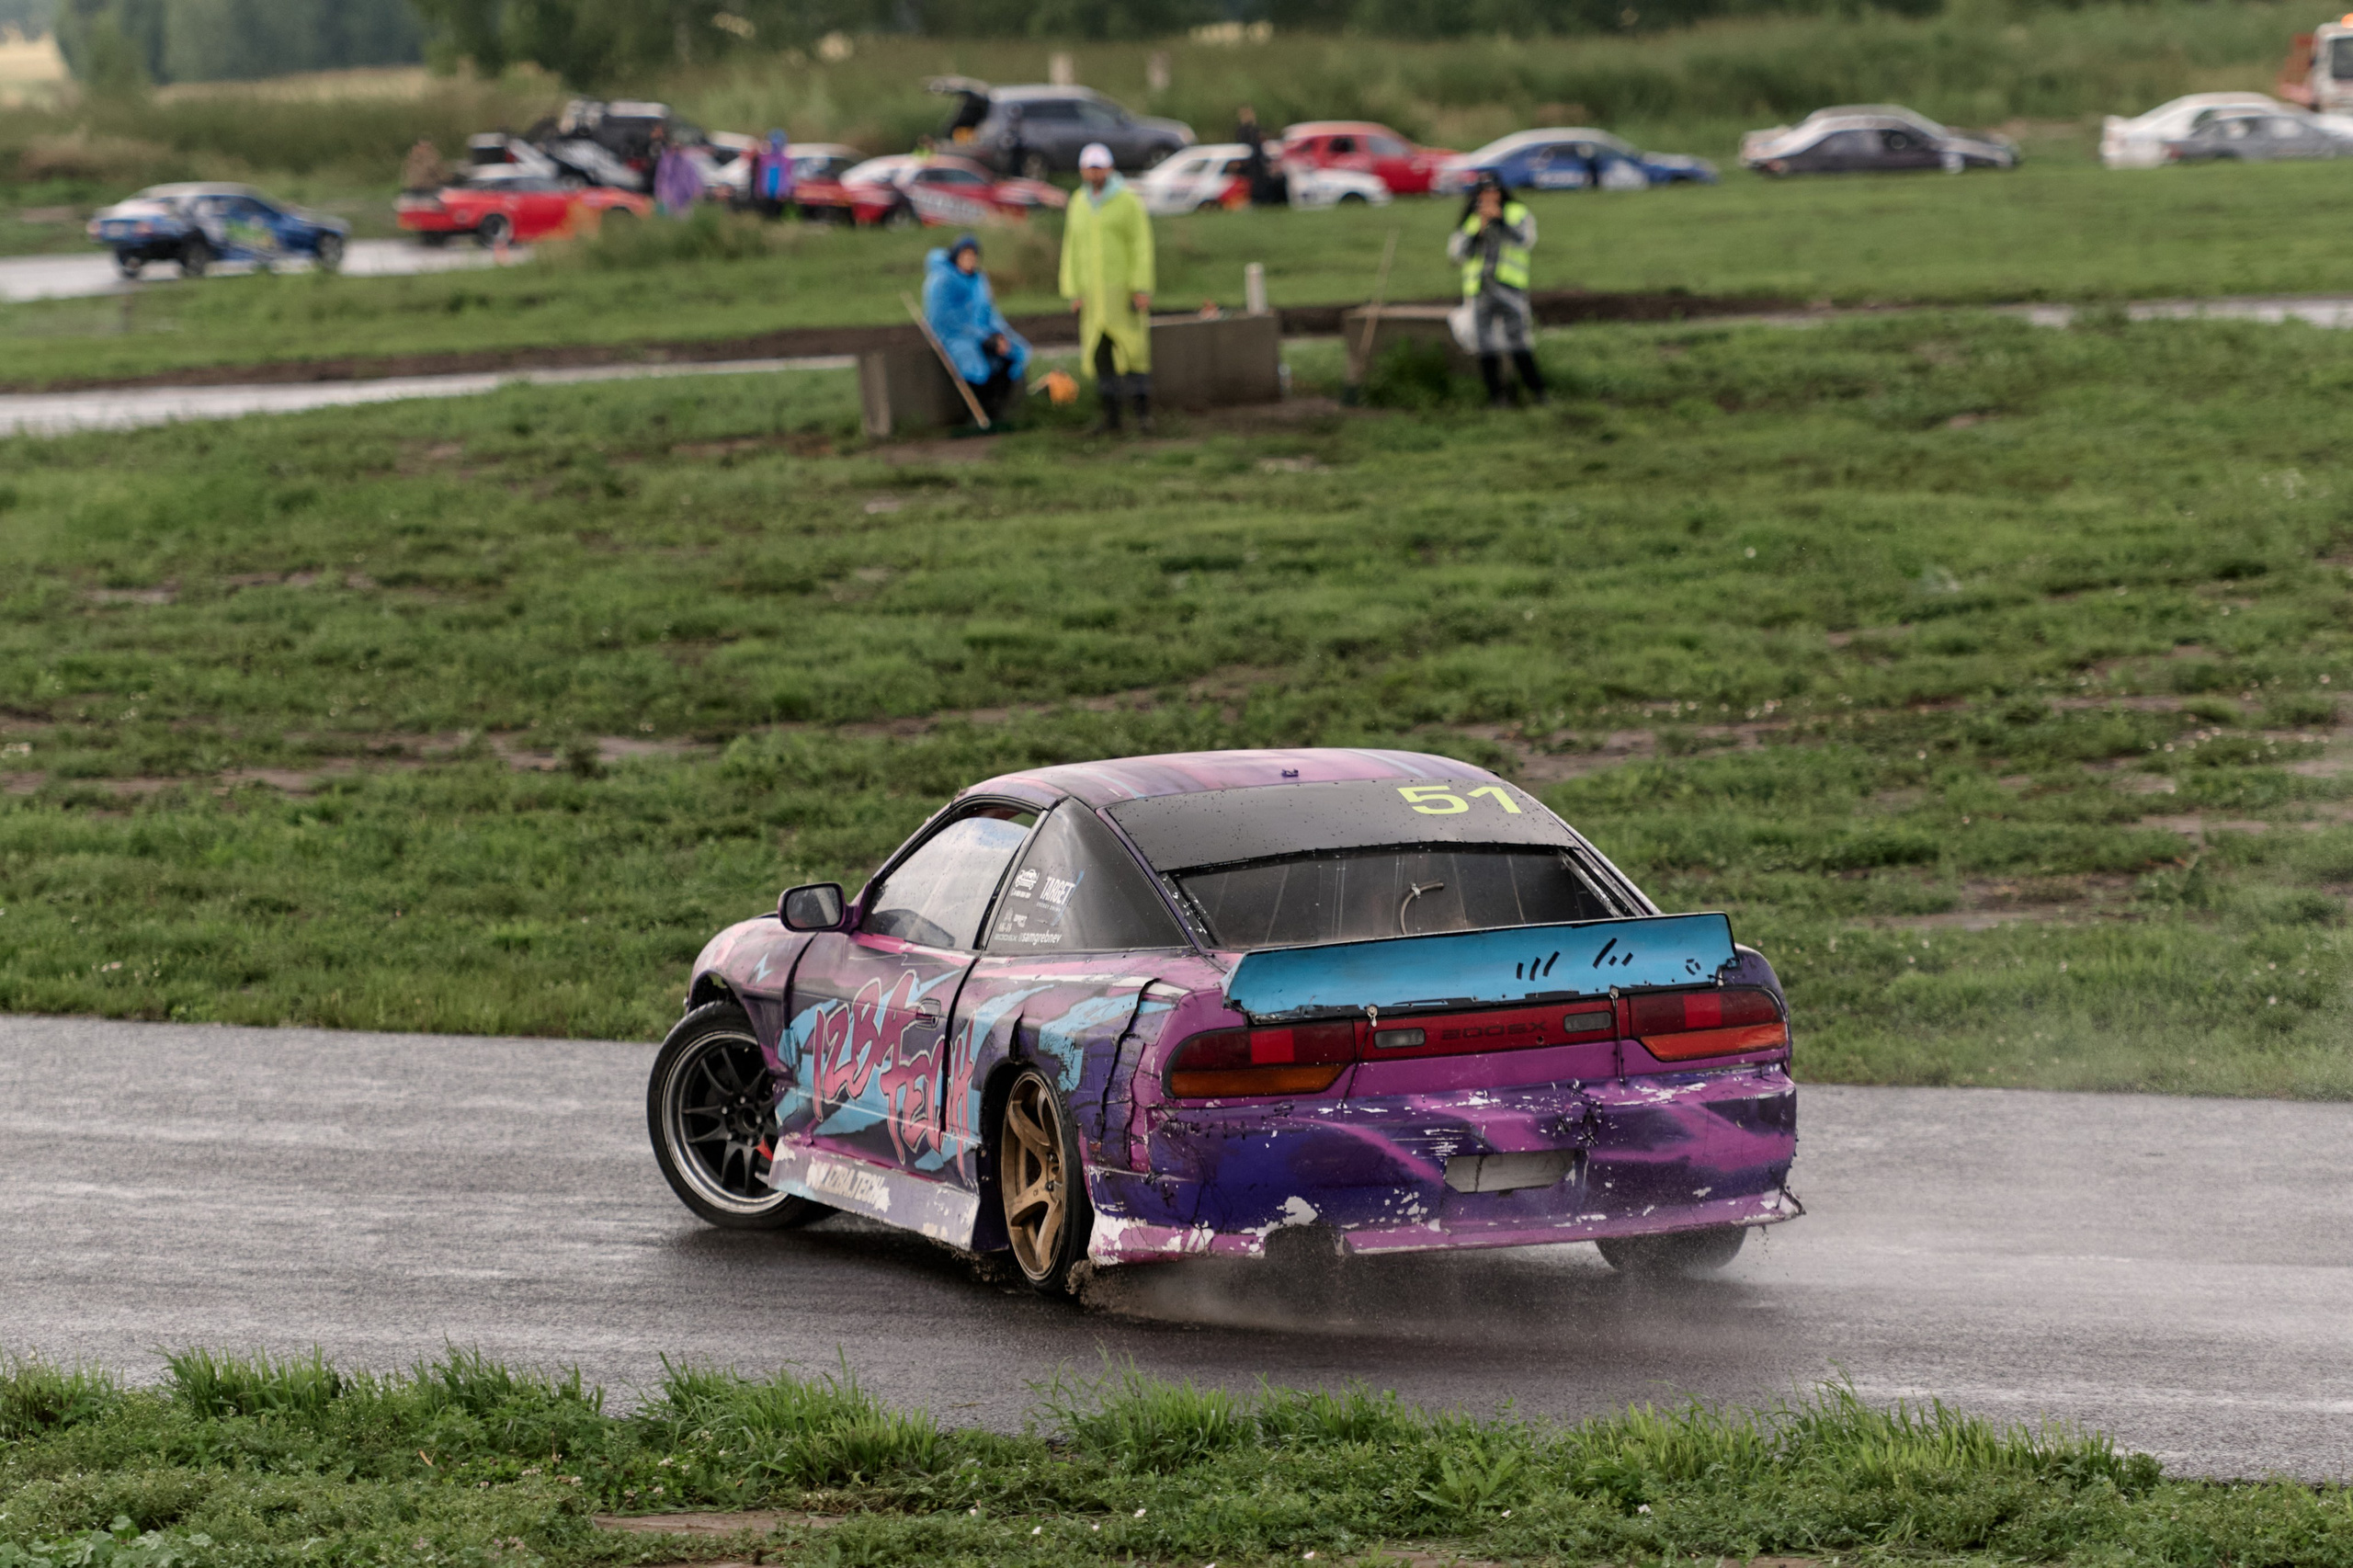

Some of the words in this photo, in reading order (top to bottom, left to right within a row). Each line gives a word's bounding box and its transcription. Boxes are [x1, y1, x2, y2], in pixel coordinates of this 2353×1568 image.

[1397, 785, 1522, 814] 51
[1040, 876, 1075, 905] TARGET
[1441, 1020, 1548, 1040] 200SX
